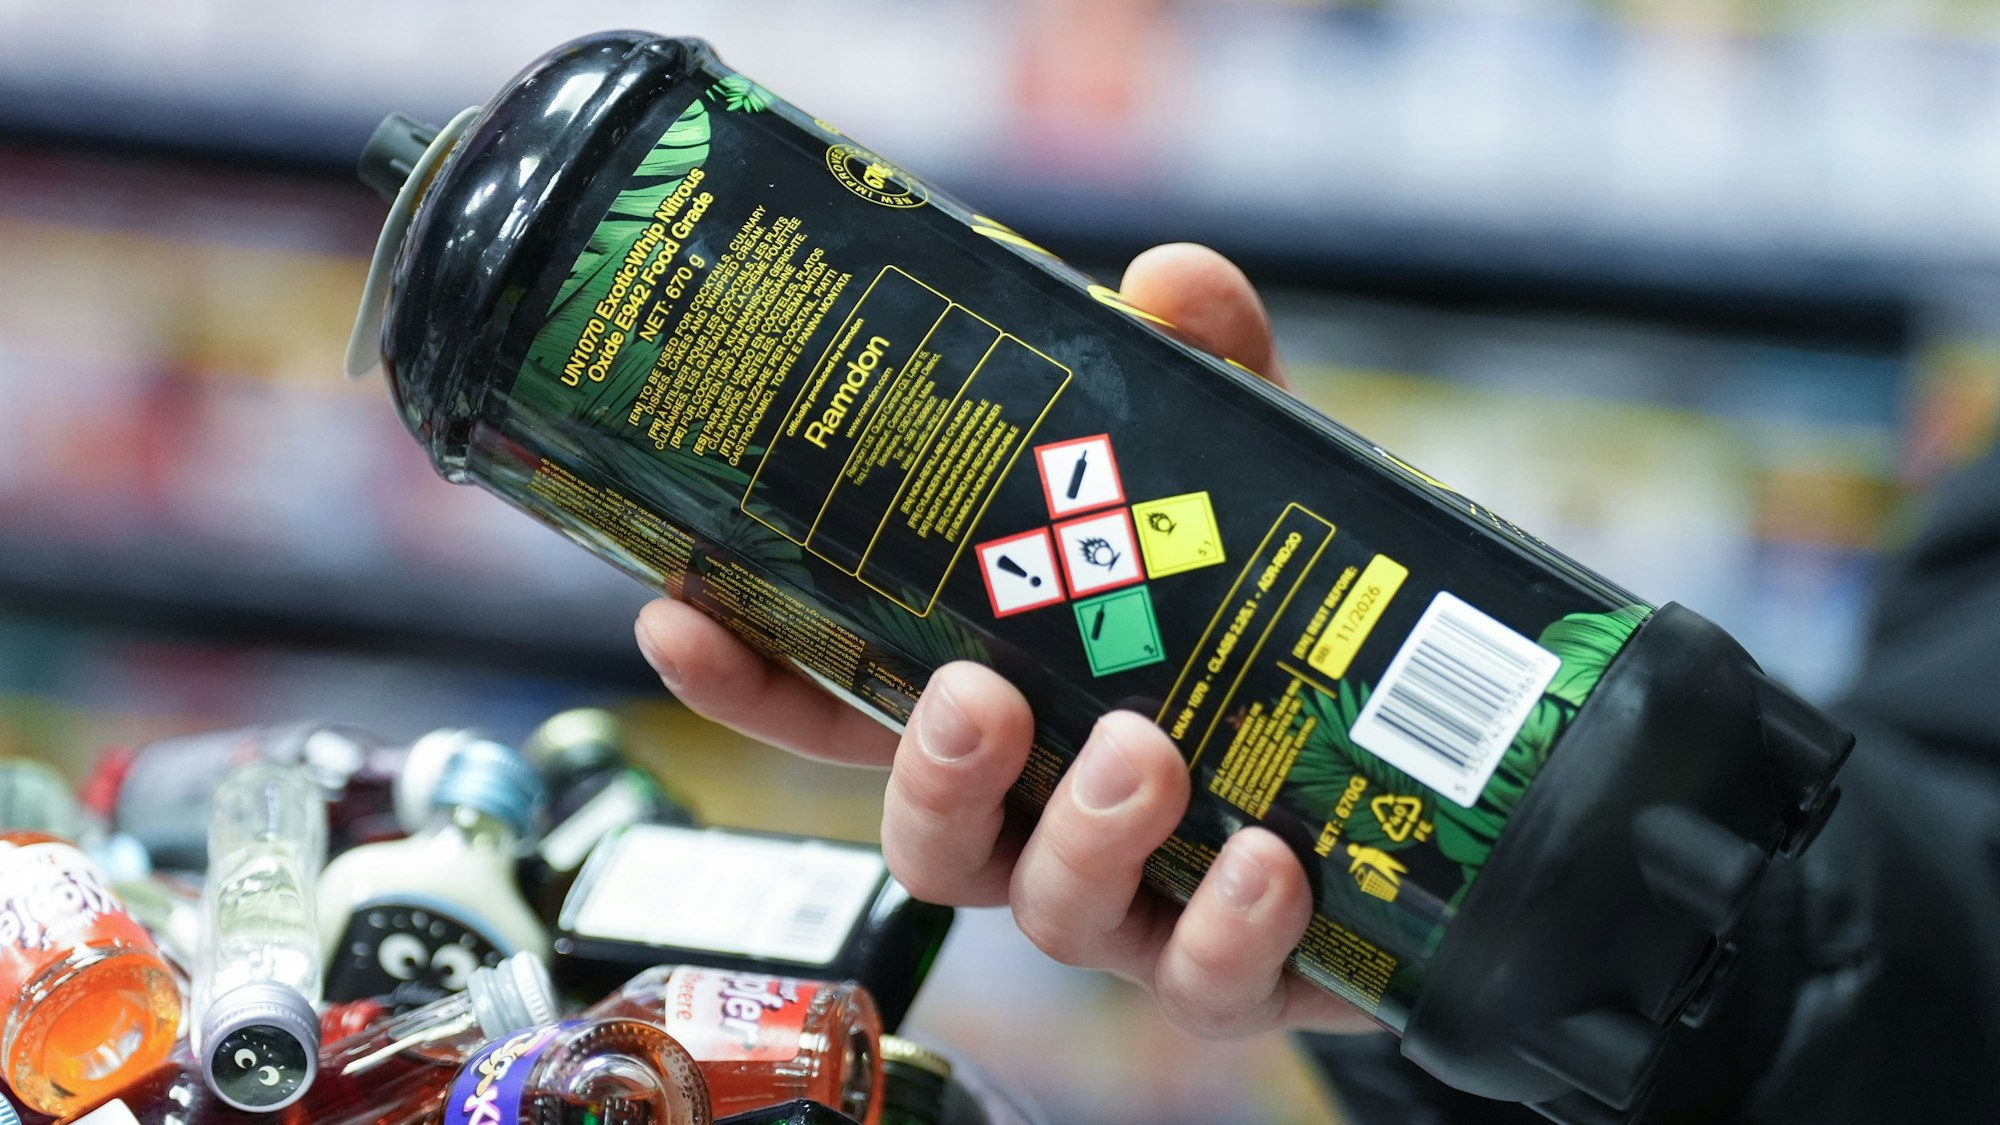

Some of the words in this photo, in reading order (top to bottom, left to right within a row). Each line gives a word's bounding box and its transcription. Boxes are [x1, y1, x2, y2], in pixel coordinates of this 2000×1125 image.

[881, 194, 914, 206] NEW
[558, 316, 608, 389] UN1070
[594, 220, 667, 321] ExoticWhip
[654, 164, 707, 224] Nitrous
[739, 259, 769, 295] CRÈME
[768, 230, 809, 278] GERICHTE,
[799, 259, 828, 294] BATIDA
[812, 268, 838, 298] PIATTI
[585, 326, 626, 385] Oxide
[613, 281, 652, 332] E942
[640, 236, 681, 286] Food
[669, 188, 716, 242] Grade
[627, 400, 647, 426] [EN]
[637, 383, 654, 403] TO
[646, 367, 663, 386] BE
[656, 335, 680, 369] USED
[674, 311, 694, 337] FOR
[688, 249, 734, 313] COCKTAILS,
[727, 203, 767, 252] CULINARY
[638, 297, 674, 344] NET:
[664, 264, 695, 302] 670
[685, 251, 707, 270] g
[724, 275, 774, 347] KULINARISCHE
[724, 306, 738, 323] ET
[732, 289, 749, 309] LA
[777, 290, 806, 328] CREMA
[817, 270, 852, 314] MONTATA
[643, 370, 675, 416] DISHES,
[667, 333, 694, 373] CAKES
[688, 309, 709, 335] AND
[703, 259, 740, 310] WHIPPED
[734, 222, 767, 262] CREAM.
[647, 416, 665, 440] [FR]
[660, 364, 692, 410] UTILISER
[685, 334, 710, 366] POUR
[703, 313, 722, 336] LES
[715, 259, 758, 316] COCKTAILS,
[750, 241, 769, 262] LES
[762, 214, 789, 244] PLATS
[694, 379, 724, 422] TORTEN
[718, 355, 737, 381] UND
[731, 332, 751, 358] ZUM
[744, 262, 797, 335] SCHLAGSAHNE
[694, 322, 729, 371] GÂTEAUX
[772, 324, 785, 336] Y
[780, 294, 820, 346] COCKTAIL,
[796, 310, 824, 346] PANNA
[691, 346, 731, 406] COCKTAILS,
[692, 432, 711, 456] [ES]
[702, 405, 724, 435] PARA
[717, 383, 736, 408] SER
[729, 348, 757, 386] USADO
[751, 332, 767, 350] EN
[759, 279, 802, 334] CÓCTELES,
[794, 245, 825, 282] PLATOS
[740, 333, 779, 389] PASTELES,
[767, 344, 787, 368] PER
[770, 352, 797, 390] TORTE
[784, 399, 813, 438] Officially
[805, 359, 836, 402] produced
[829, 348, 844, 363] by
[837, 316, 864, 352] Ramdon
[791, 344, 802, 355] E
[684, 368, 702, 392] LES
[735, 366, 774, 425] UTILIZZARE
[802, 331, 891, 450] Ramdon
[844, 365, 893, 439] www.ramdon.com
[886, 401, 907, 430] Central
[901, 373, 926, 404] Business
[917, 378, 936, 400] Malta
[653, 389, 691, 451] CULINAIRES,
[670, 424, 688, 449] [DE]
[677, 404, 697, 427] FÜR
[705, 386, 747, 451] CULINARIOS,
[726, 421, 743, 441] DA
[727, 386, 778, 467] GASTRONOMICI,
[844, 446, 868, 478] Ramdon
[870, 412, 888, 435] Quad
[882, 388, 902, 415] Central
[905, 358, 923, 379] Level
[719, 437, 735, 457] [IT]
[898, 495, 915, 514] [EN]
[907, 434, 951, 498] NON-REFILLABLE
[944, 398, 974, 438] CYLINDER
[905, 509, 922, 529] [FR]
[936, 455, 953, 476] NON
[947, 397, 990, 459] RECHARGEABLE
[915, 518, 932, 538] [DE]
[924, 495, 944, 522] NICHT
[973, 401, 1003, 440] ZYLINDER
[933, 515, 949, 534] [ES]
[942, 480, 969, 518] CILINDRO
[963, 467, 977, 483] NO
[970, 419, 1007, 471] RECARGABLE
[950, 489, 979, 530] BOMBOLA
[972, 473, 989, 493] NON
[1305, 604, 1331, 637] BEST
[1322, 563, 1359, 610] BEFORE:
[1334, 582, 1382, 644] 11/2026
[1185, 678, 1211, 710] 1070
[1205, 630, 1239, 675] CLASS
[1312, 816, 1343, 858] NET:
[1332, 772, 1369, 821] 670G
[1411, 818, 1435, 843] FE
